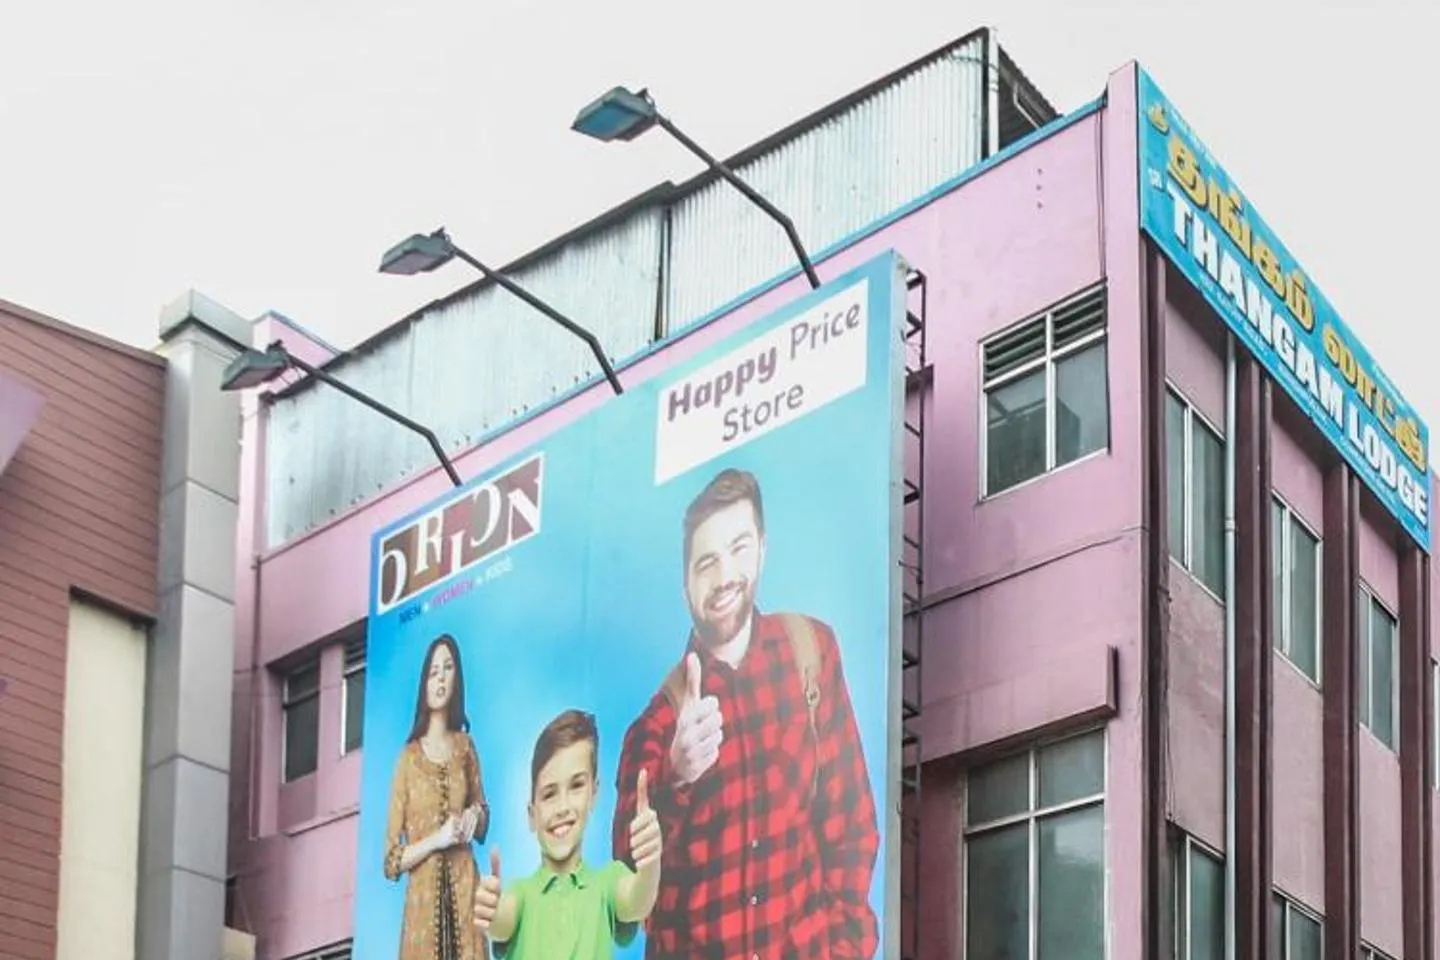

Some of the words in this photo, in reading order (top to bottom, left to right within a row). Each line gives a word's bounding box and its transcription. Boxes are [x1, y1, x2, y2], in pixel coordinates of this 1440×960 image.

[1167, 134, 1318, 336] தங்கம்
[667, 347, 777, 422] Happy
[789, 302, 862, 362] Price
[721, 383, 804, 443] Store
[1166, 181, 1345, 432] THANGAM
[1348, 402, 1429, 527] LODGE
[380, 466, 545, 613] ORION
